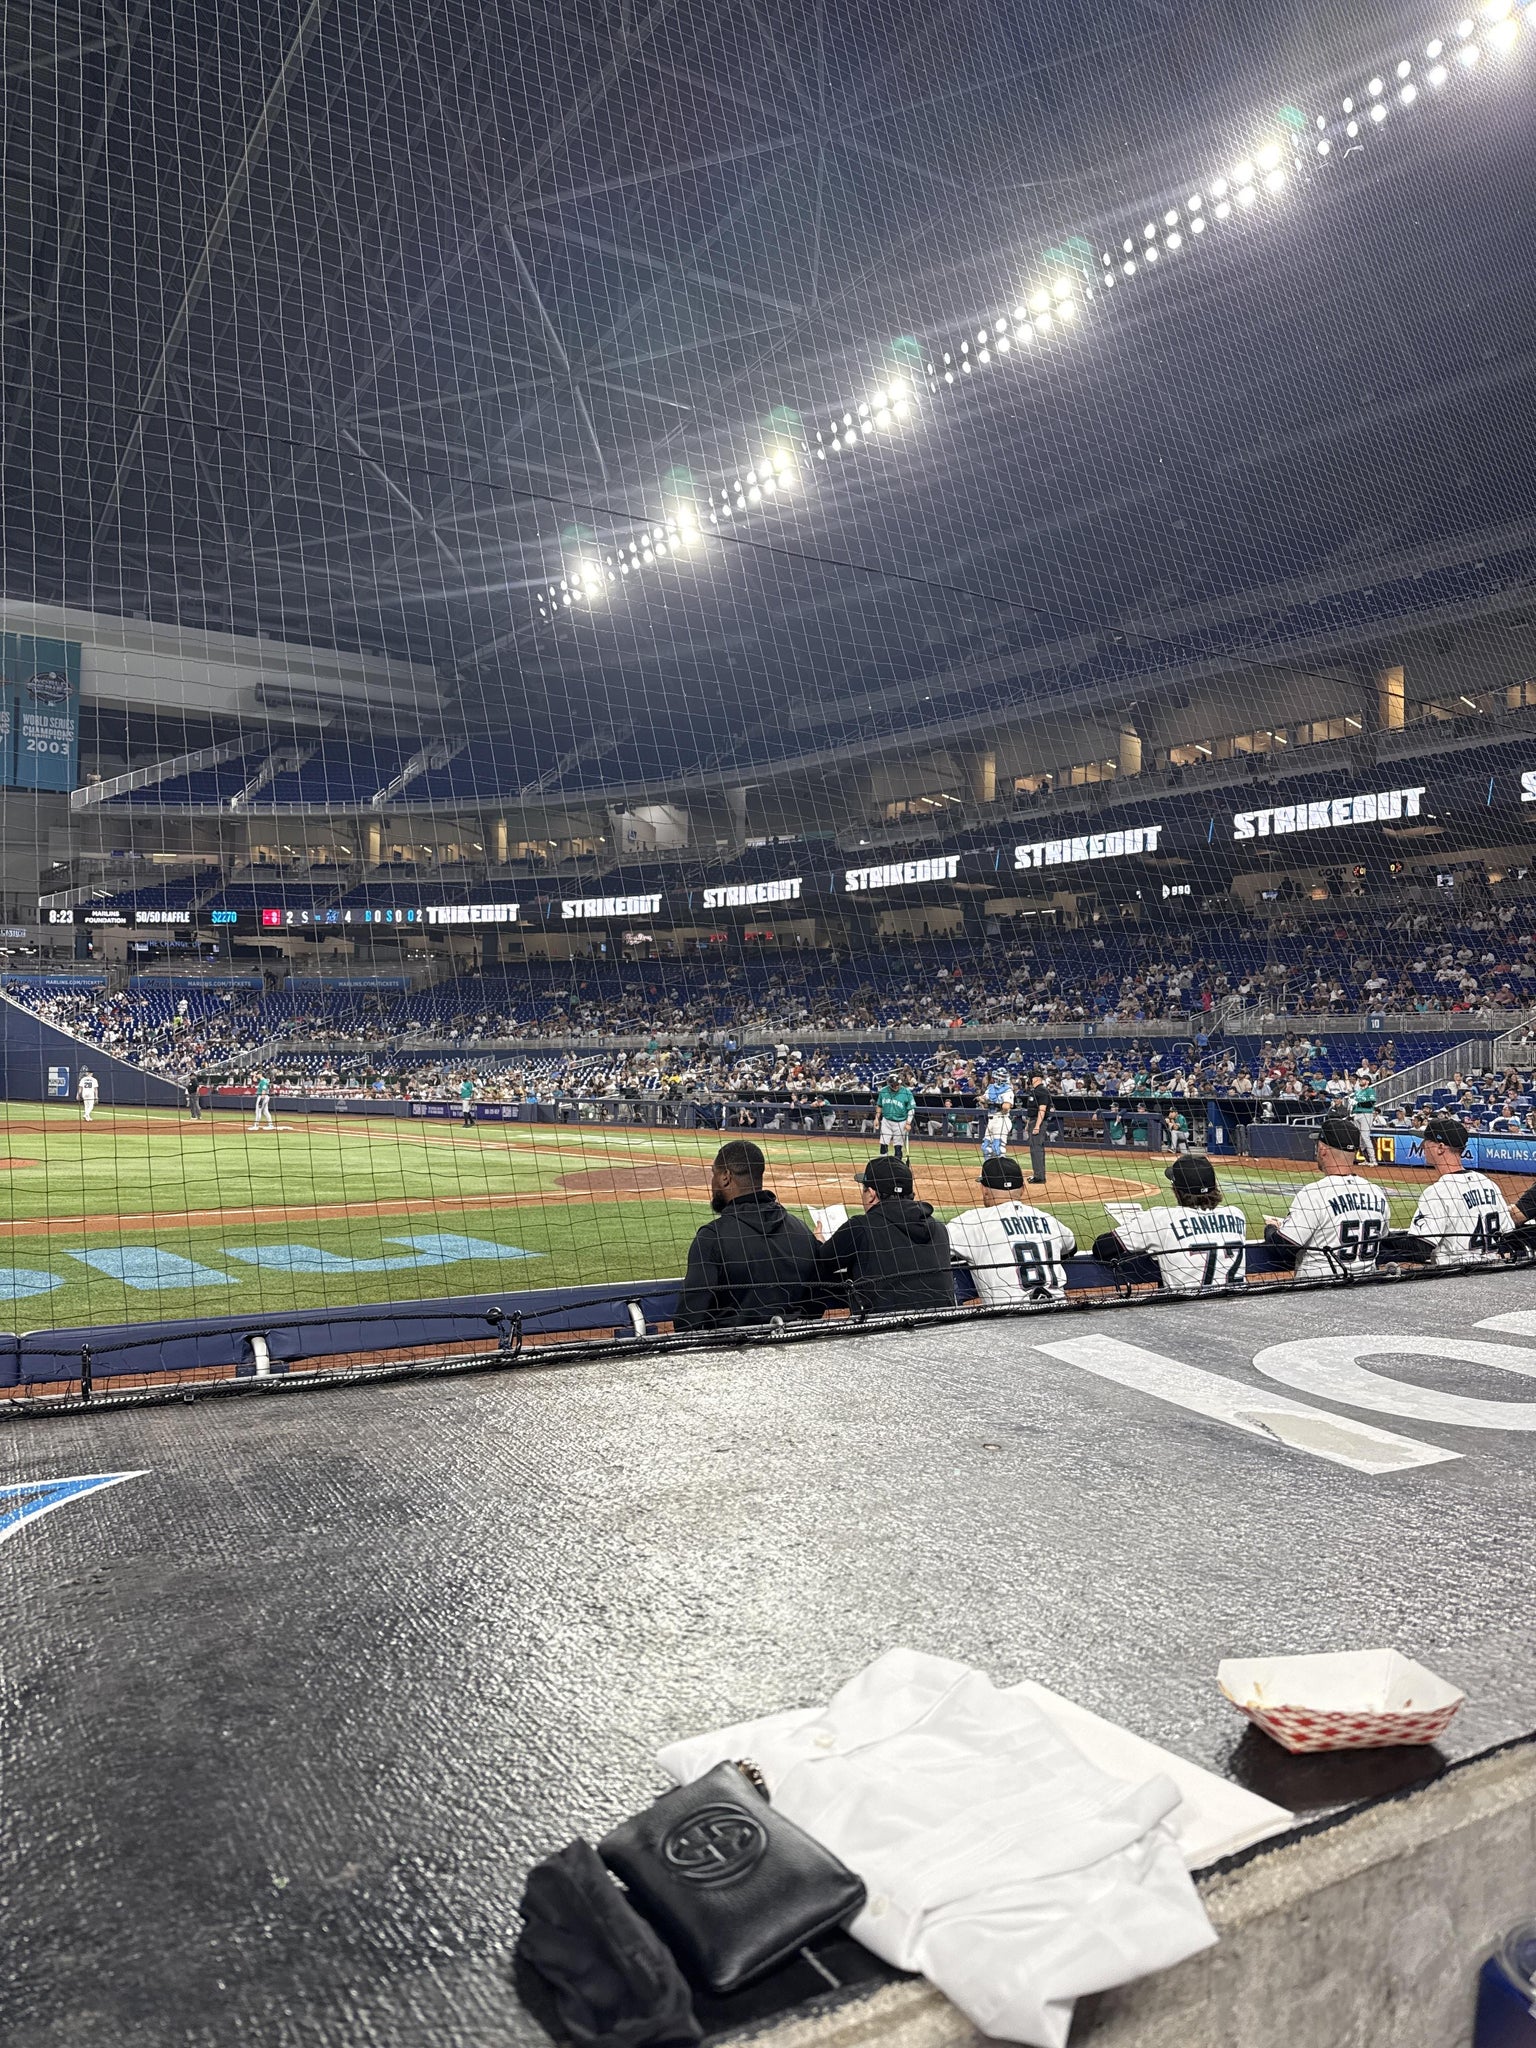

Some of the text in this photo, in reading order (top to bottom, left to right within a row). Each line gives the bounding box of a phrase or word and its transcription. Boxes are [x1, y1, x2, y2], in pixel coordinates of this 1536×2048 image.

[23, 714, 49, 727] WORLD
[50, 716, 75, 731] SERIES
[23, 725, 74, 741] CHAMPIONS
[26, 739, 69, 755] 2003
[1234, 787, 1426, 840] STRIKEOUT
[1014, 825, 1163, 870] STRIKEOUT
[844, 855, 961, 891] STRIKEOUT
[702, 877, 803, 909] STRIKEOUT
[48, 910, 74, 924] 8:23
[91, 910, 120, 918] MARLINS
[135, 911, 191, 923] 50/50 RAFFLE
[211, 910, 238, 924] $2270
[286, 910, 294, 924] 2
[344, 910, 352, 923] 4
[416, 909, 423, 922] 2
[426, 903, 520, 924] TRIKEOUT
[561, 894, 663, 919] STRIKEOUT
[1370, 1018, 1380, 1029] 10
[1328, 1192, 1387, 1217] MARCELLO
[1462, 1187, 1497, 1210] BUTLER
[1000, 1215, 1052, 1237] DRIVER
[1011, 1239, 1059, 1291] 81
[1189, 1240, 1245, 1287] 72
